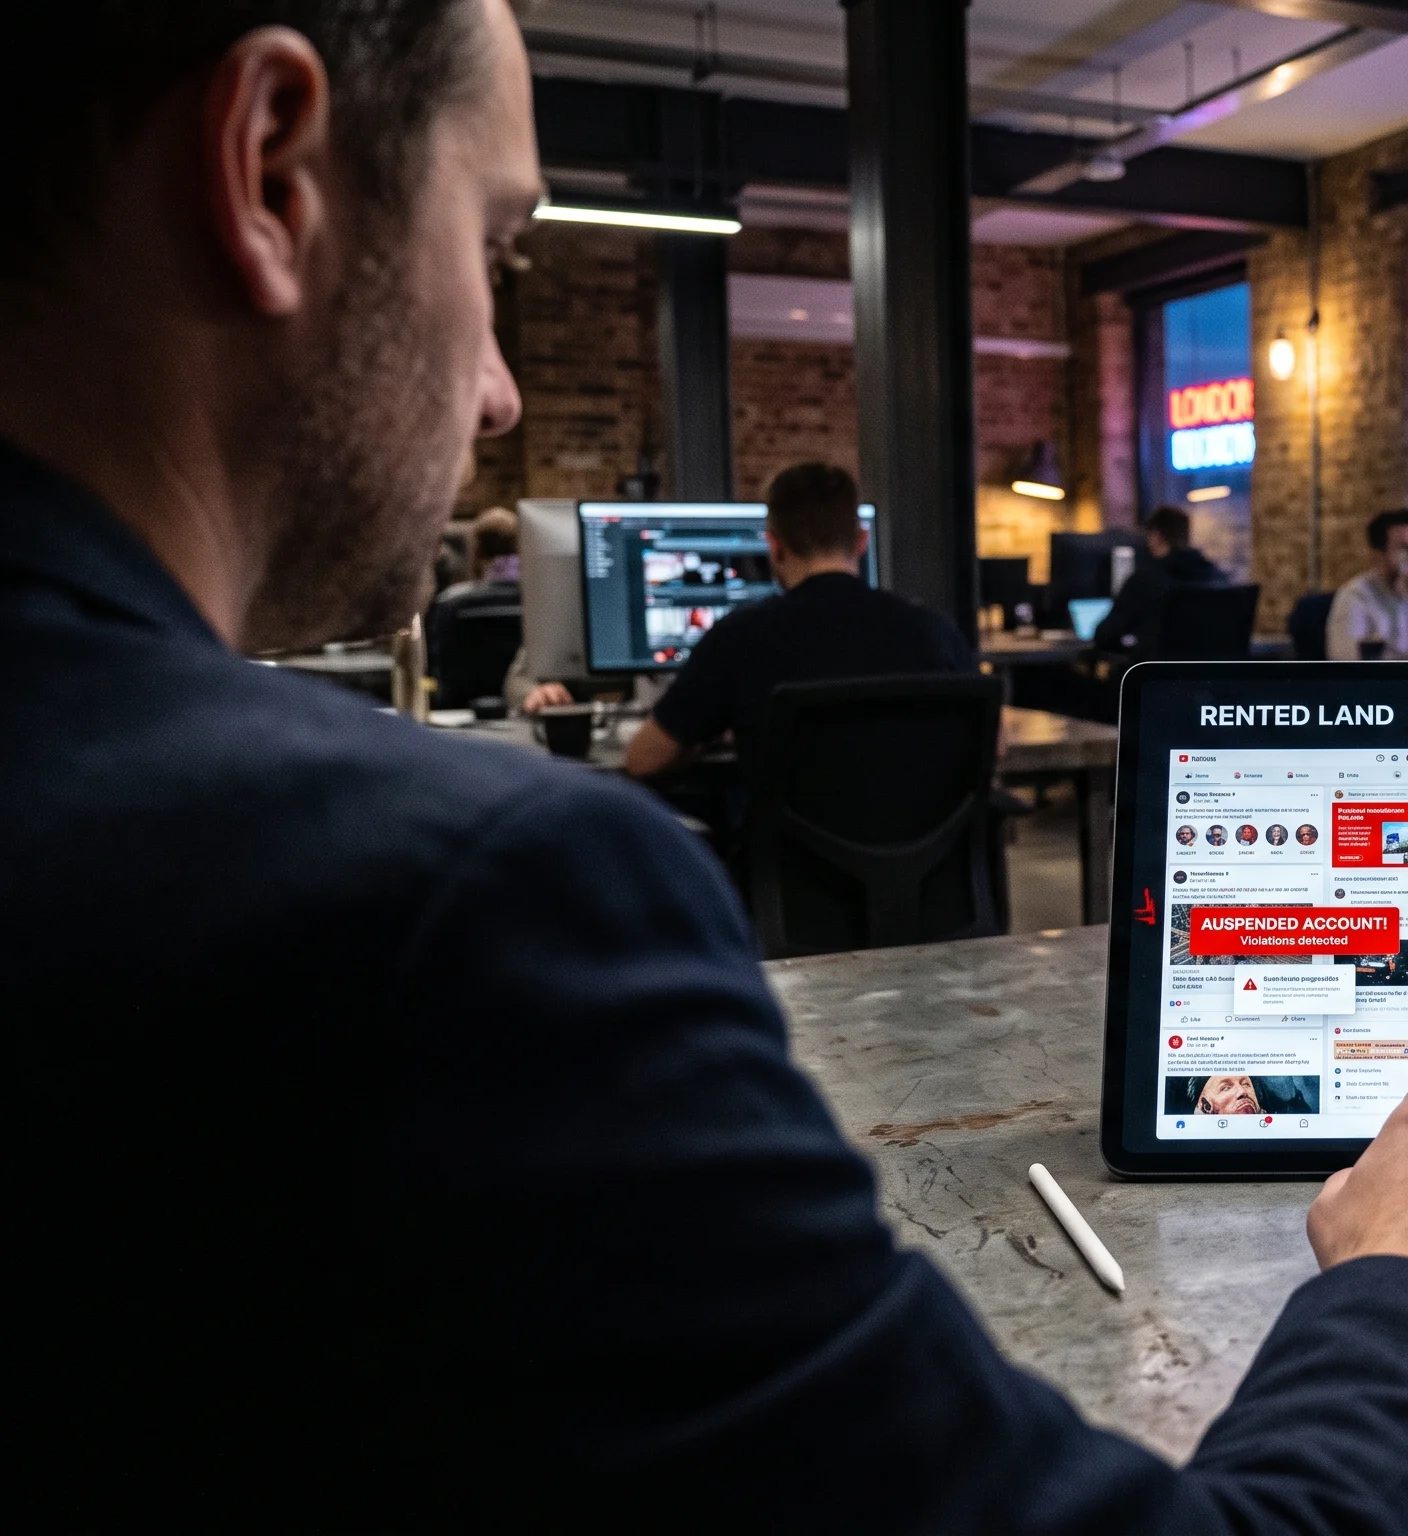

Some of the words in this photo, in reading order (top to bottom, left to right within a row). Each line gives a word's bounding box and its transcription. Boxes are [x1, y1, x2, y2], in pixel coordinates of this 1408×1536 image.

[1201, 705, 1310, 726] RENTED
[1319, 705, 1394, 726] LAND
[1201, 917, 1299, 931] AUSPENDED
[1302, 917, 1388, 931] ACCOUNT!
[1240, 935, 1295, 946] Violations
[1298, 935, 1348, 946] detected
